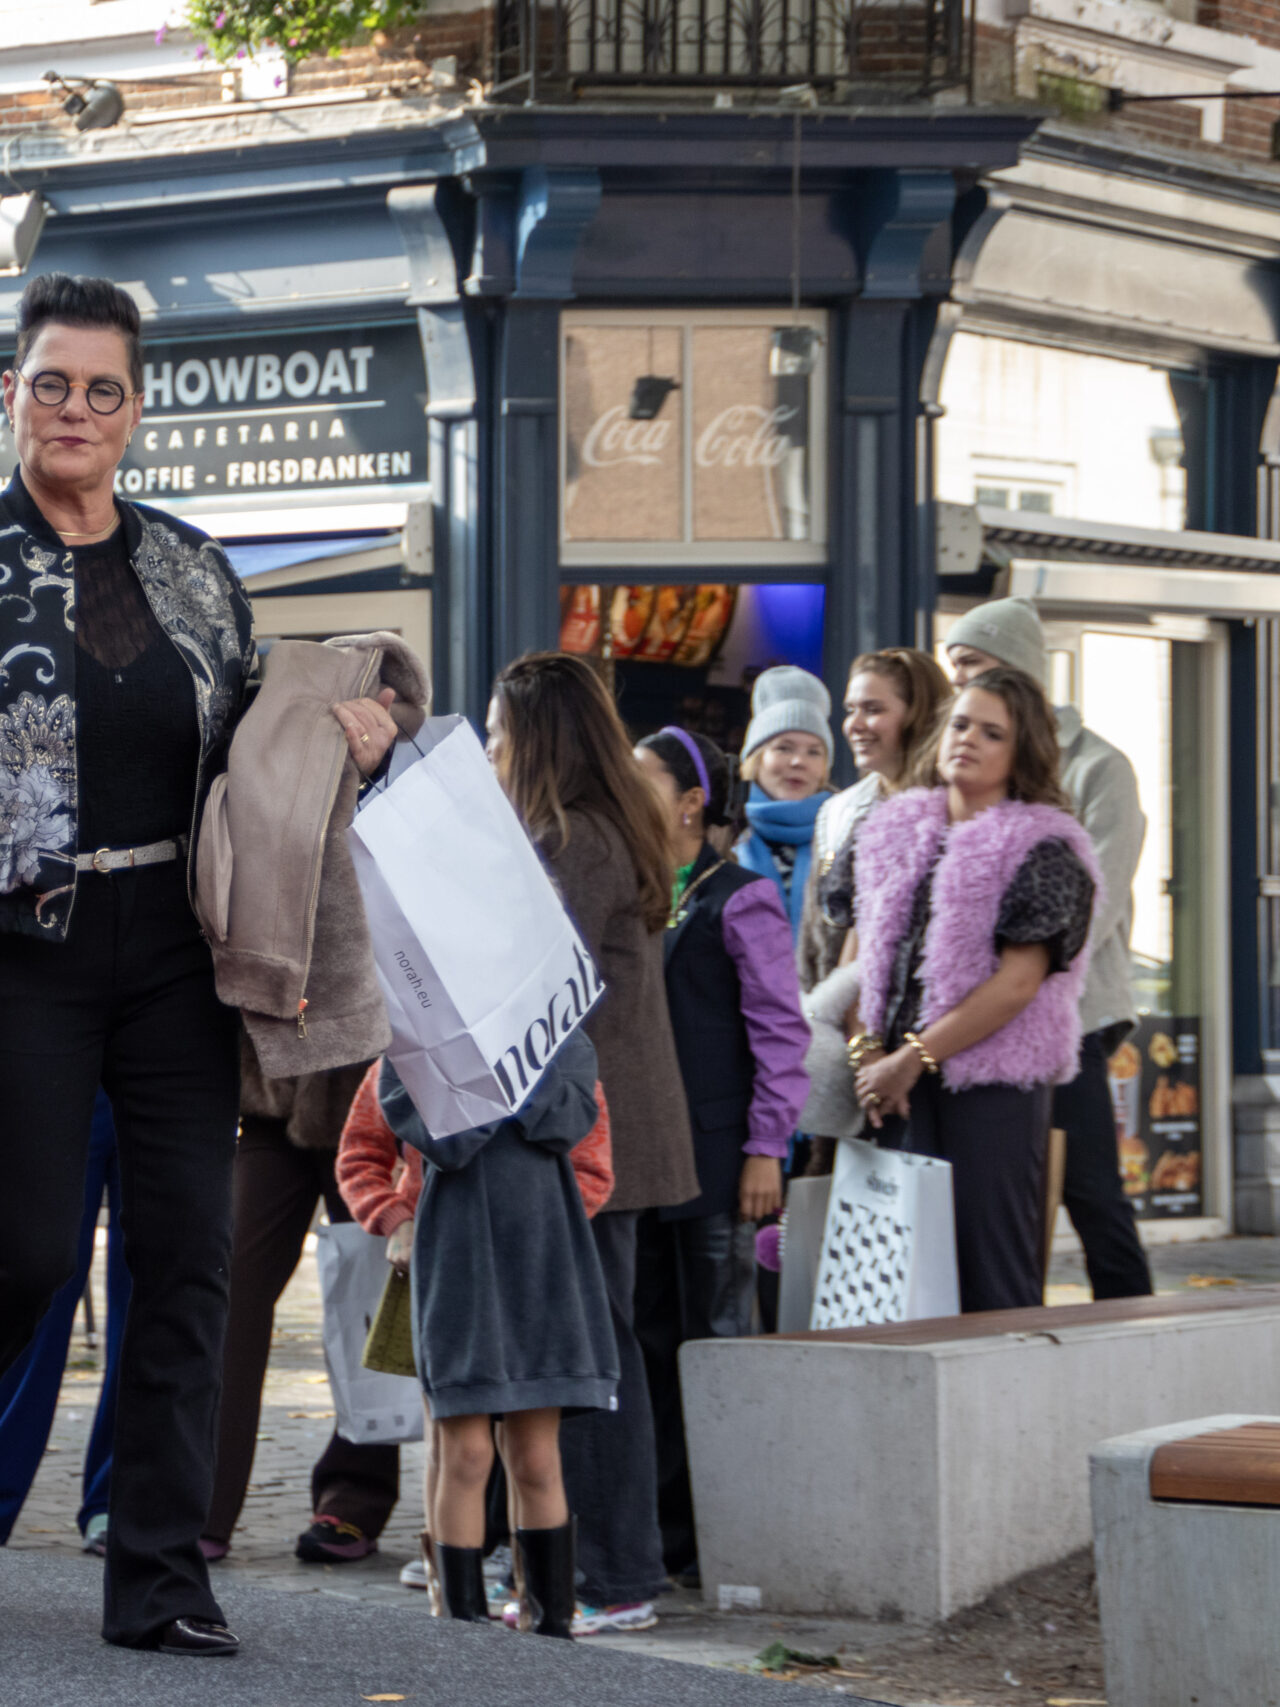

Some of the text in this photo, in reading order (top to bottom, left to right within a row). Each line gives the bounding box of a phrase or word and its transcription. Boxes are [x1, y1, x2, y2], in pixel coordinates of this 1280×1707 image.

[144, 346, 374, 408] HOWBOAT
[144, 417, 346, 452] CAFETARIA
[695, 405, 801, 467] Cola
[226, 451, 412, 487] FRISDRANKEN
[393, 950, 433, 1009] norah.eu
